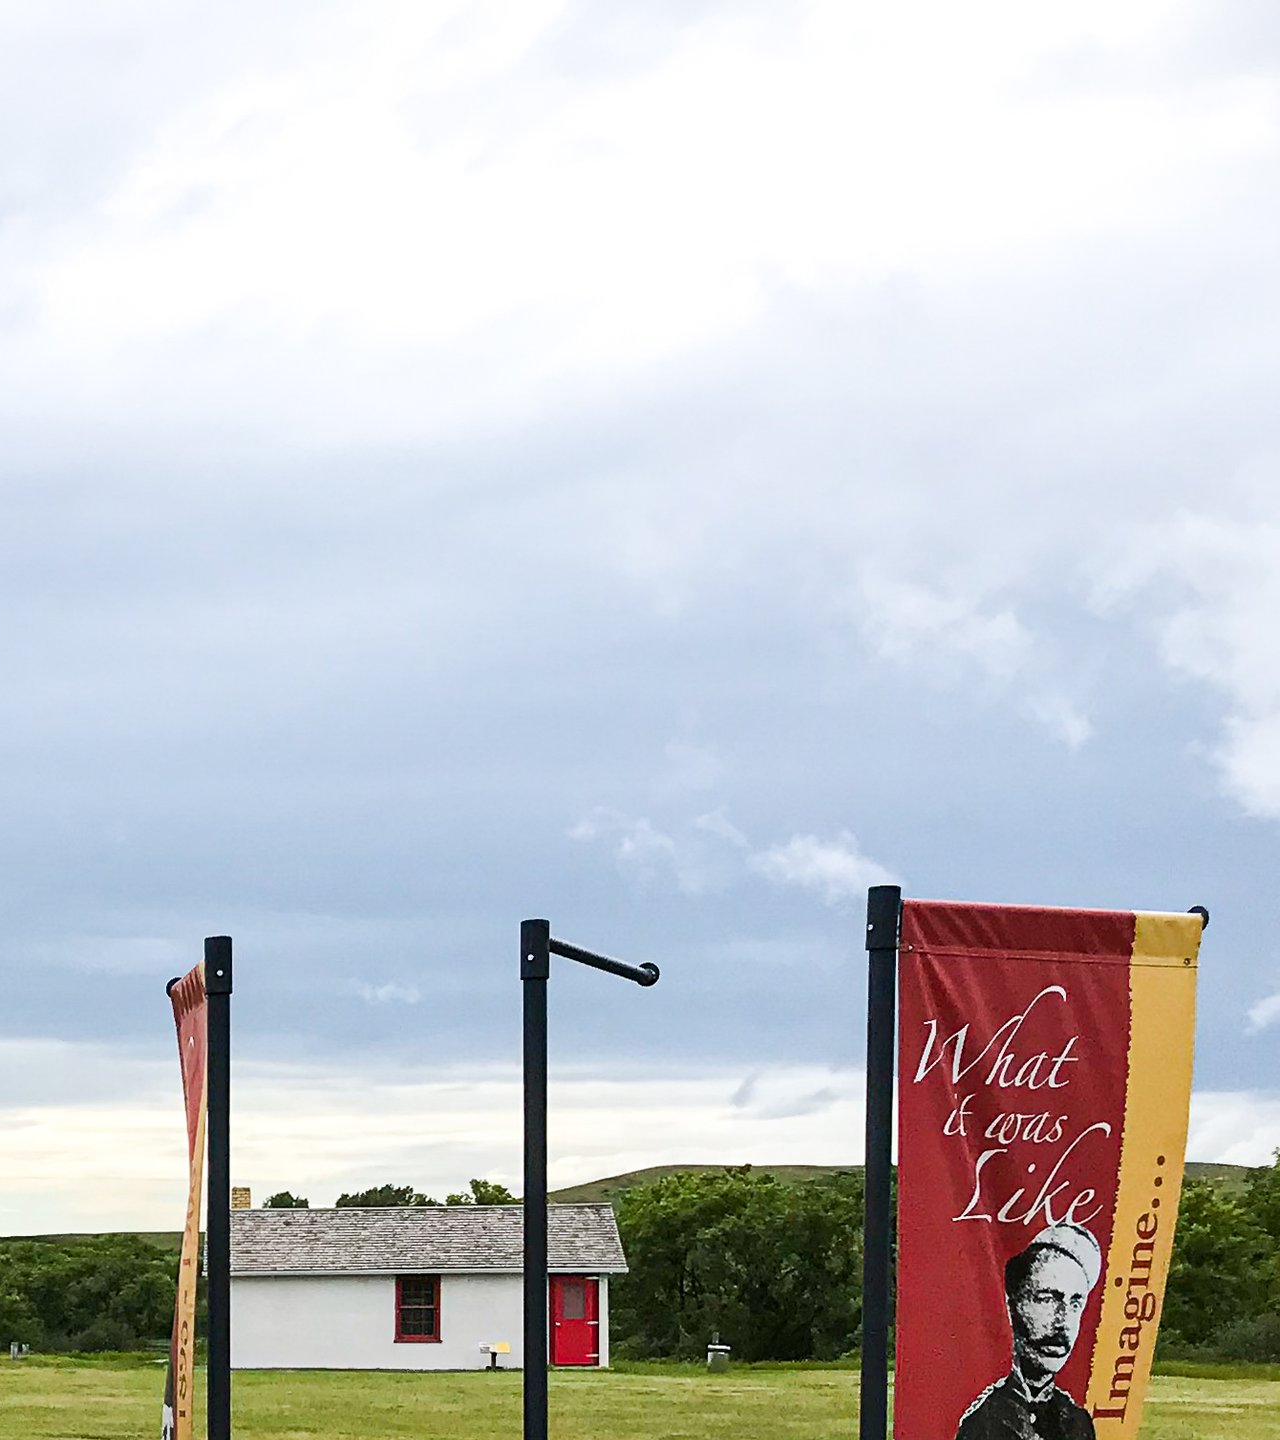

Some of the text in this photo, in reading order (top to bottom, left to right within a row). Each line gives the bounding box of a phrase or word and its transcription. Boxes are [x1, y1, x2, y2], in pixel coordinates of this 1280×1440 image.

[913, 984, 1080, 1090] What
[942, 1093, 1068, 1145] it was
[951, 1121, 1112, 1227] Like
[1092, 1155, 1165, 1424] Imagine...
